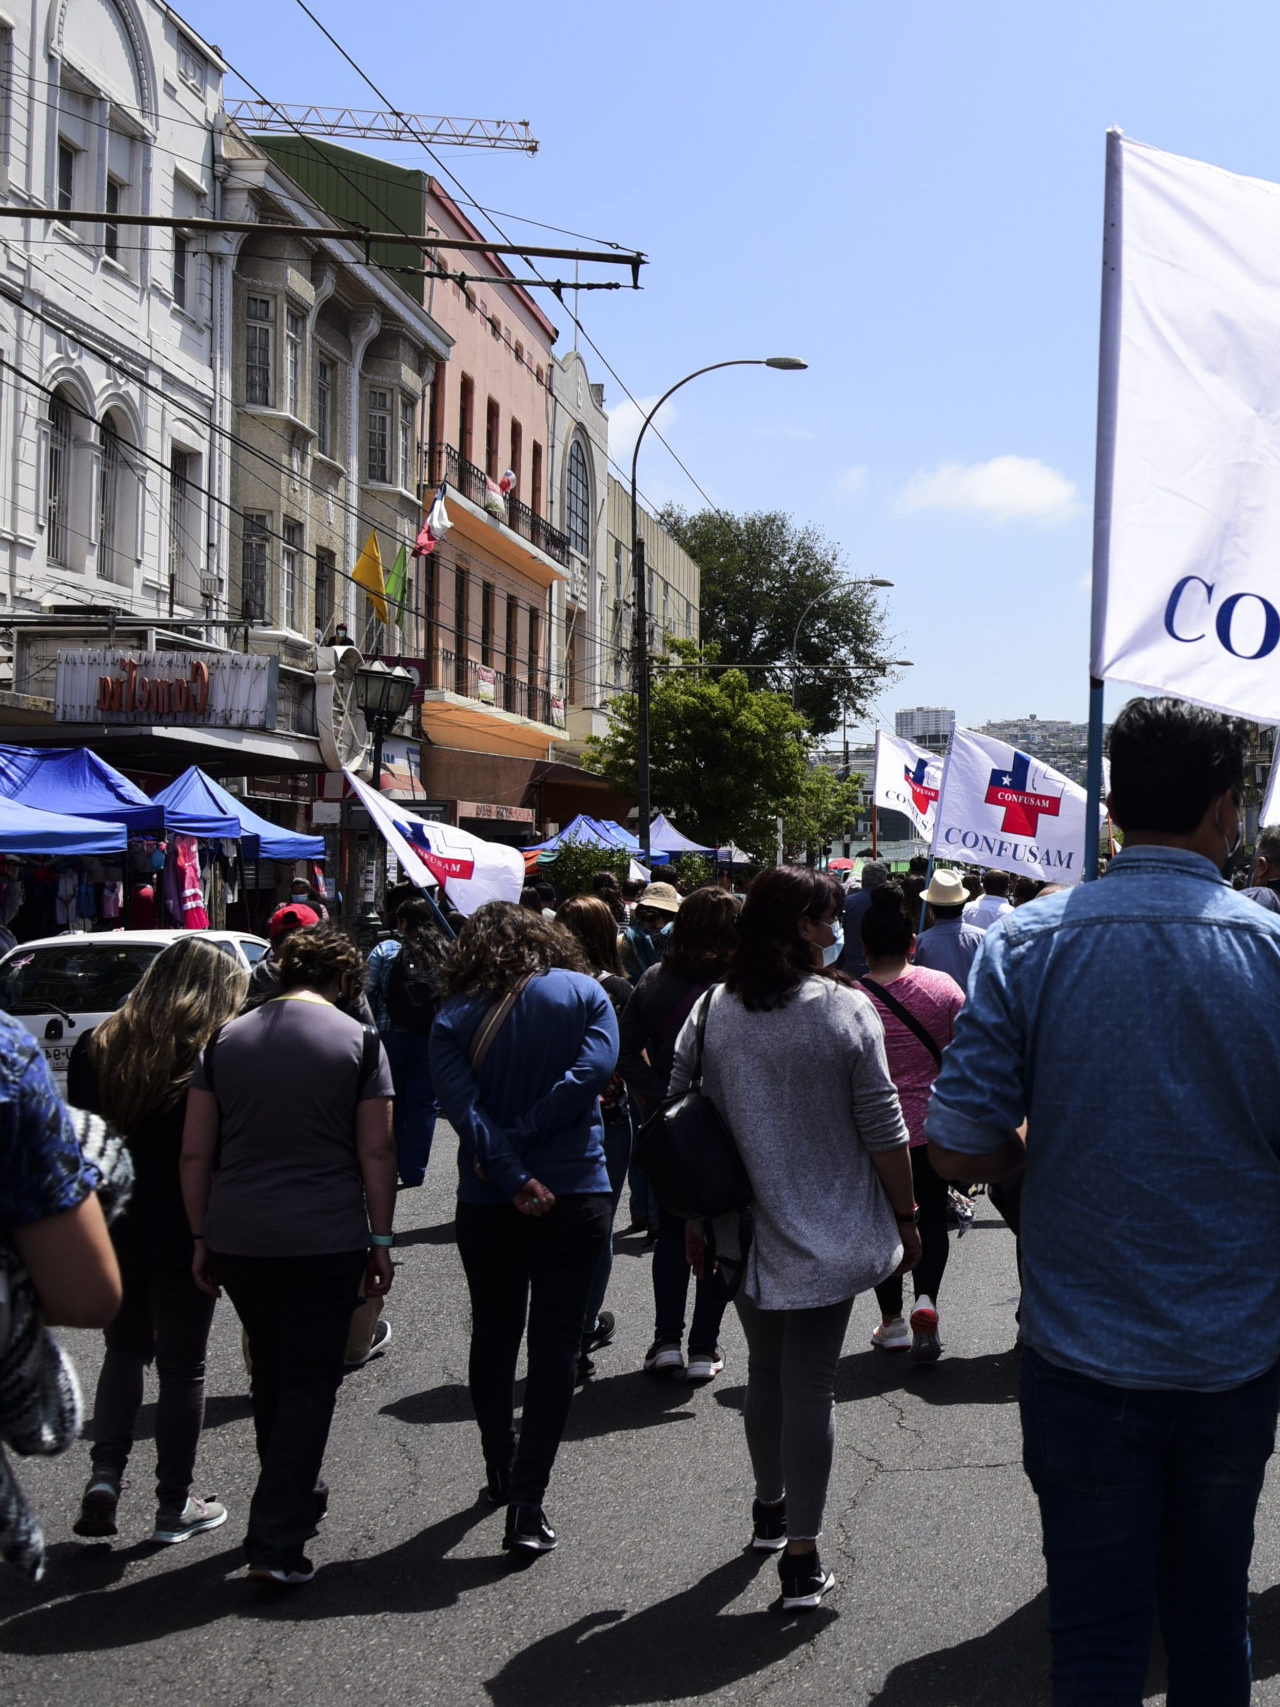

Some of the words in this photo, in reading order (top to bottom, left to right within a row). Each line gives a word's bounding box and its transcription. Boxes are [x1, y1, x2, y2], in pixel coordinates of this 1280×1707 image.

[997, 791, 1050, 809] CONFUSAM
[414, 847, 461, 873] NFUSAM
[944, 826, 1076, 869] CONFUSAM
